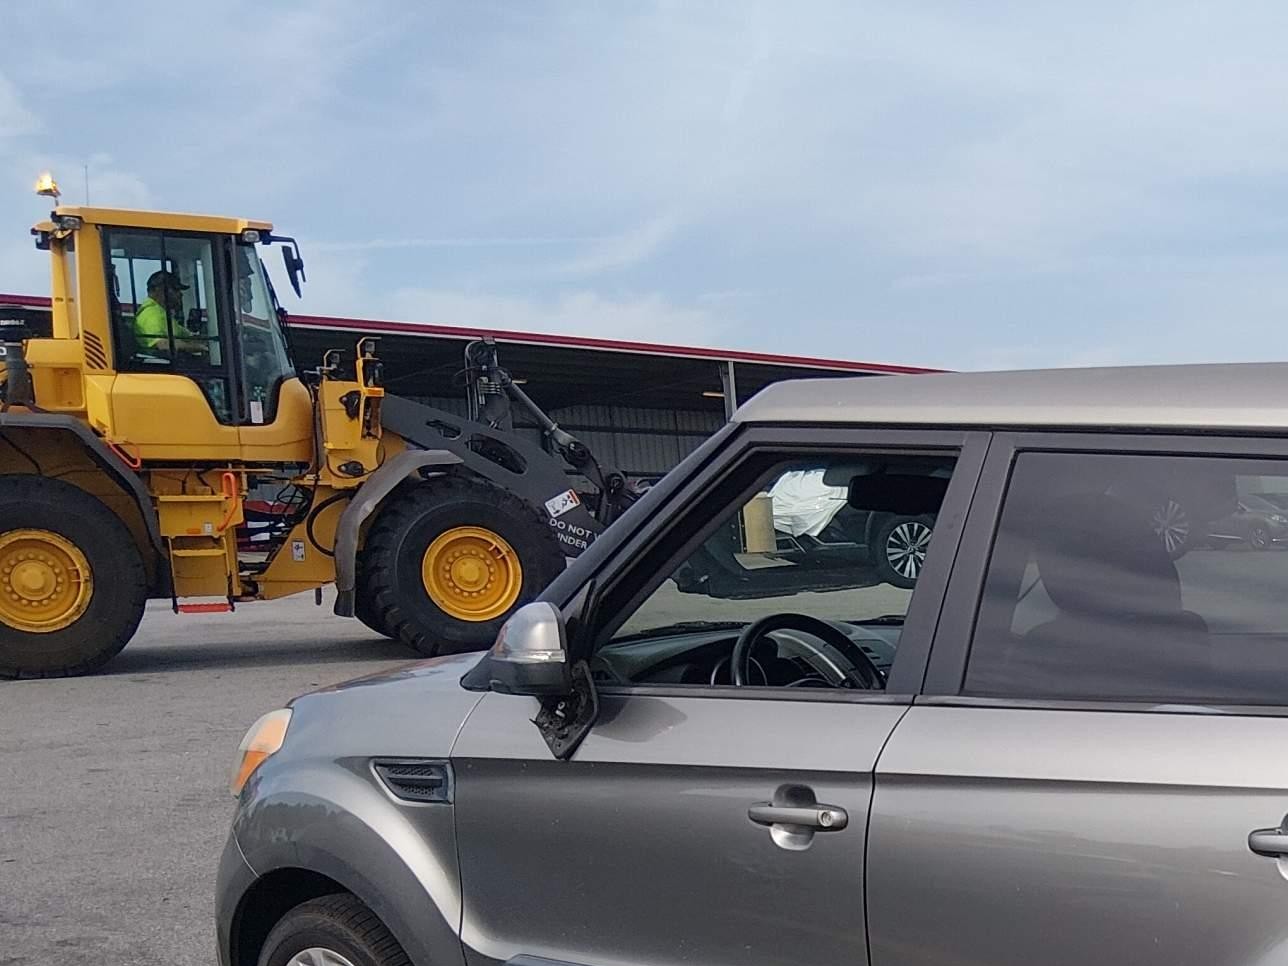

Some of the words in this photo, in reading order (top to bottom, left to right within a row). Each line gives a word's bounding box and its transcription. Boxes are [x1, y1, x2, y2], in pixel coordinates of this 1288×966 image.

[549, 518, 566, 529] DO
[568, 524, 592, 539] NOT
[557, 532, 587, 550] NDER
